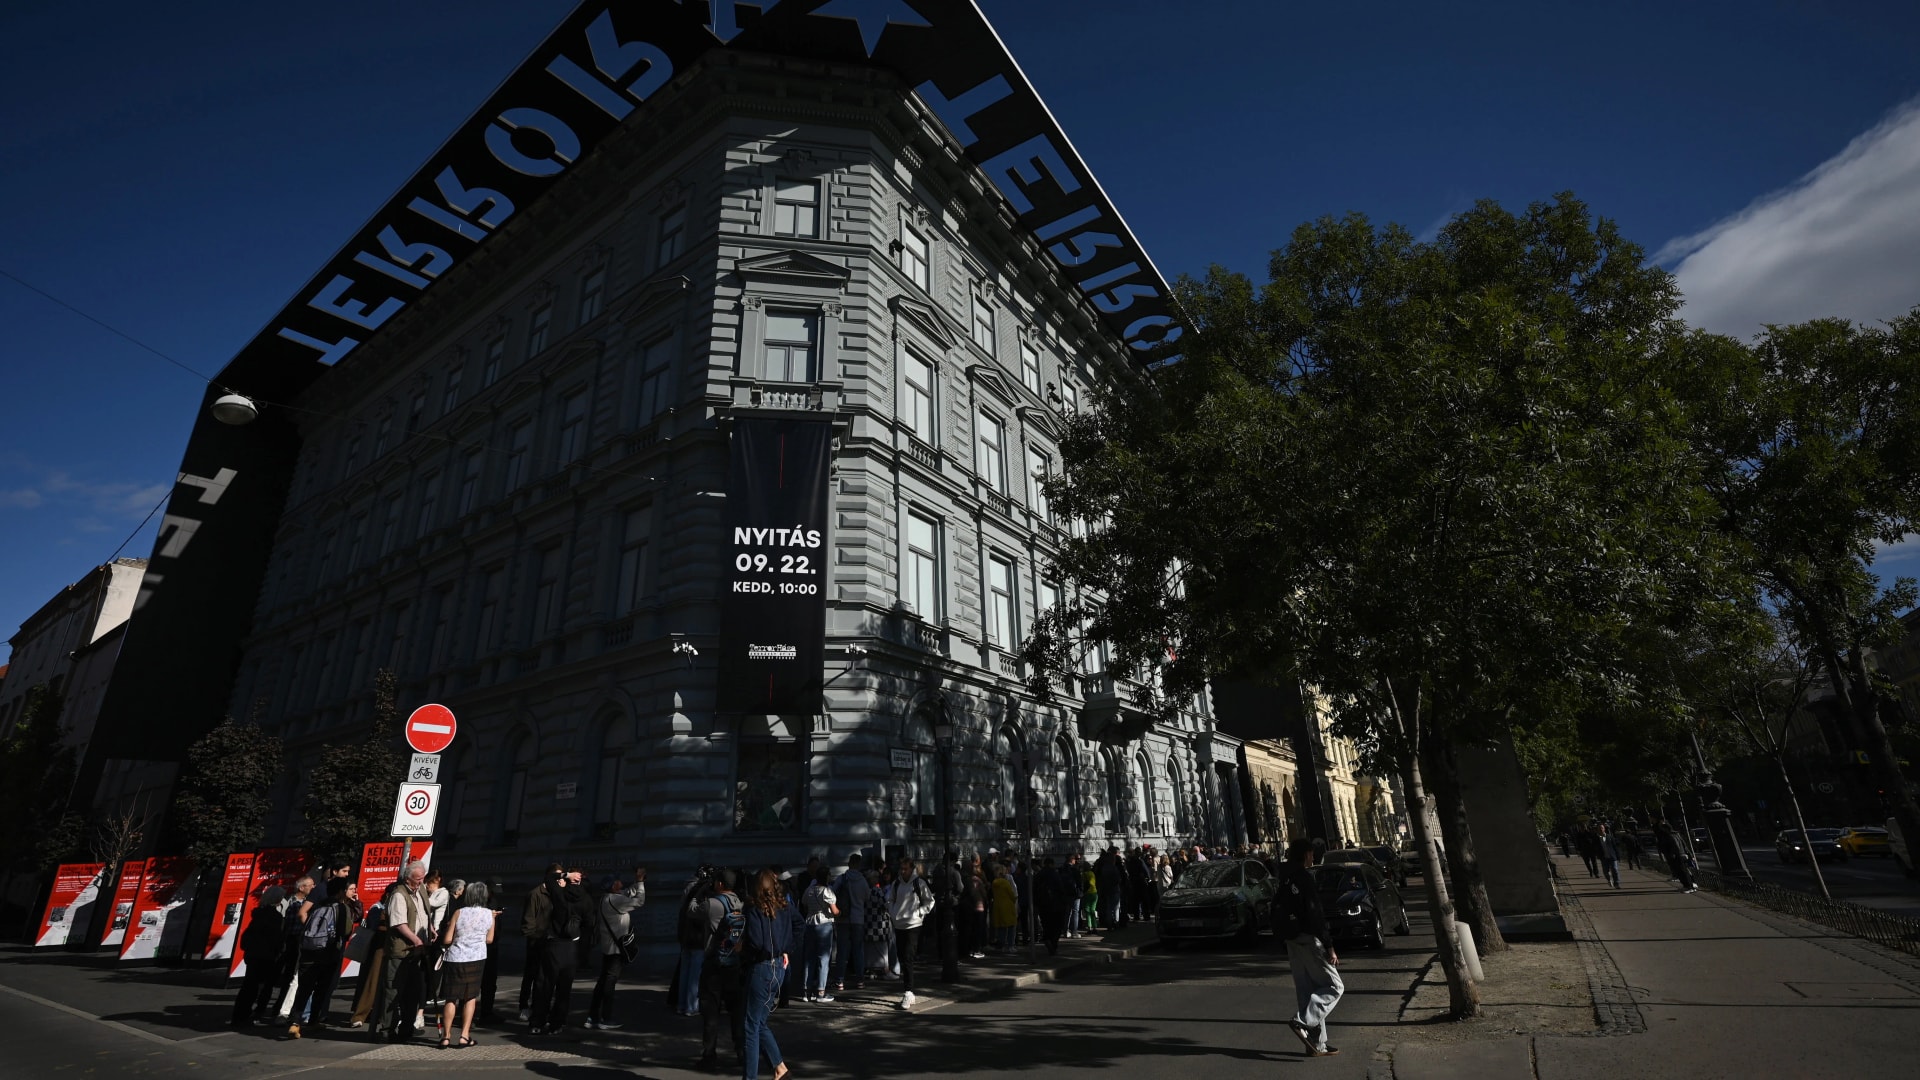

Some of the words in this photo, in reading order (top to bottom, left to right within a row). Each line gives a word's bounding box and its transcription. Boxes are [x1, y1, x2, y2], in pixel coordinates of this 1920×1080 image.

[734, 524, 821, 548] NYITÁS
[735, 554, 774, 573] 09.
[780, 555, 817, 575] 22.
[733, 581, 775, 595] KEDD,
[779, 582, 818, 595] 10:00
[414, 755, 439, 765] KIVÉVE
[410, 796, 426, 810] 30
[401, 823, 425, 831] ZÓNA
[368, 845, 384, 856] KÉT
[386, 845, 403, 856] HÉT
